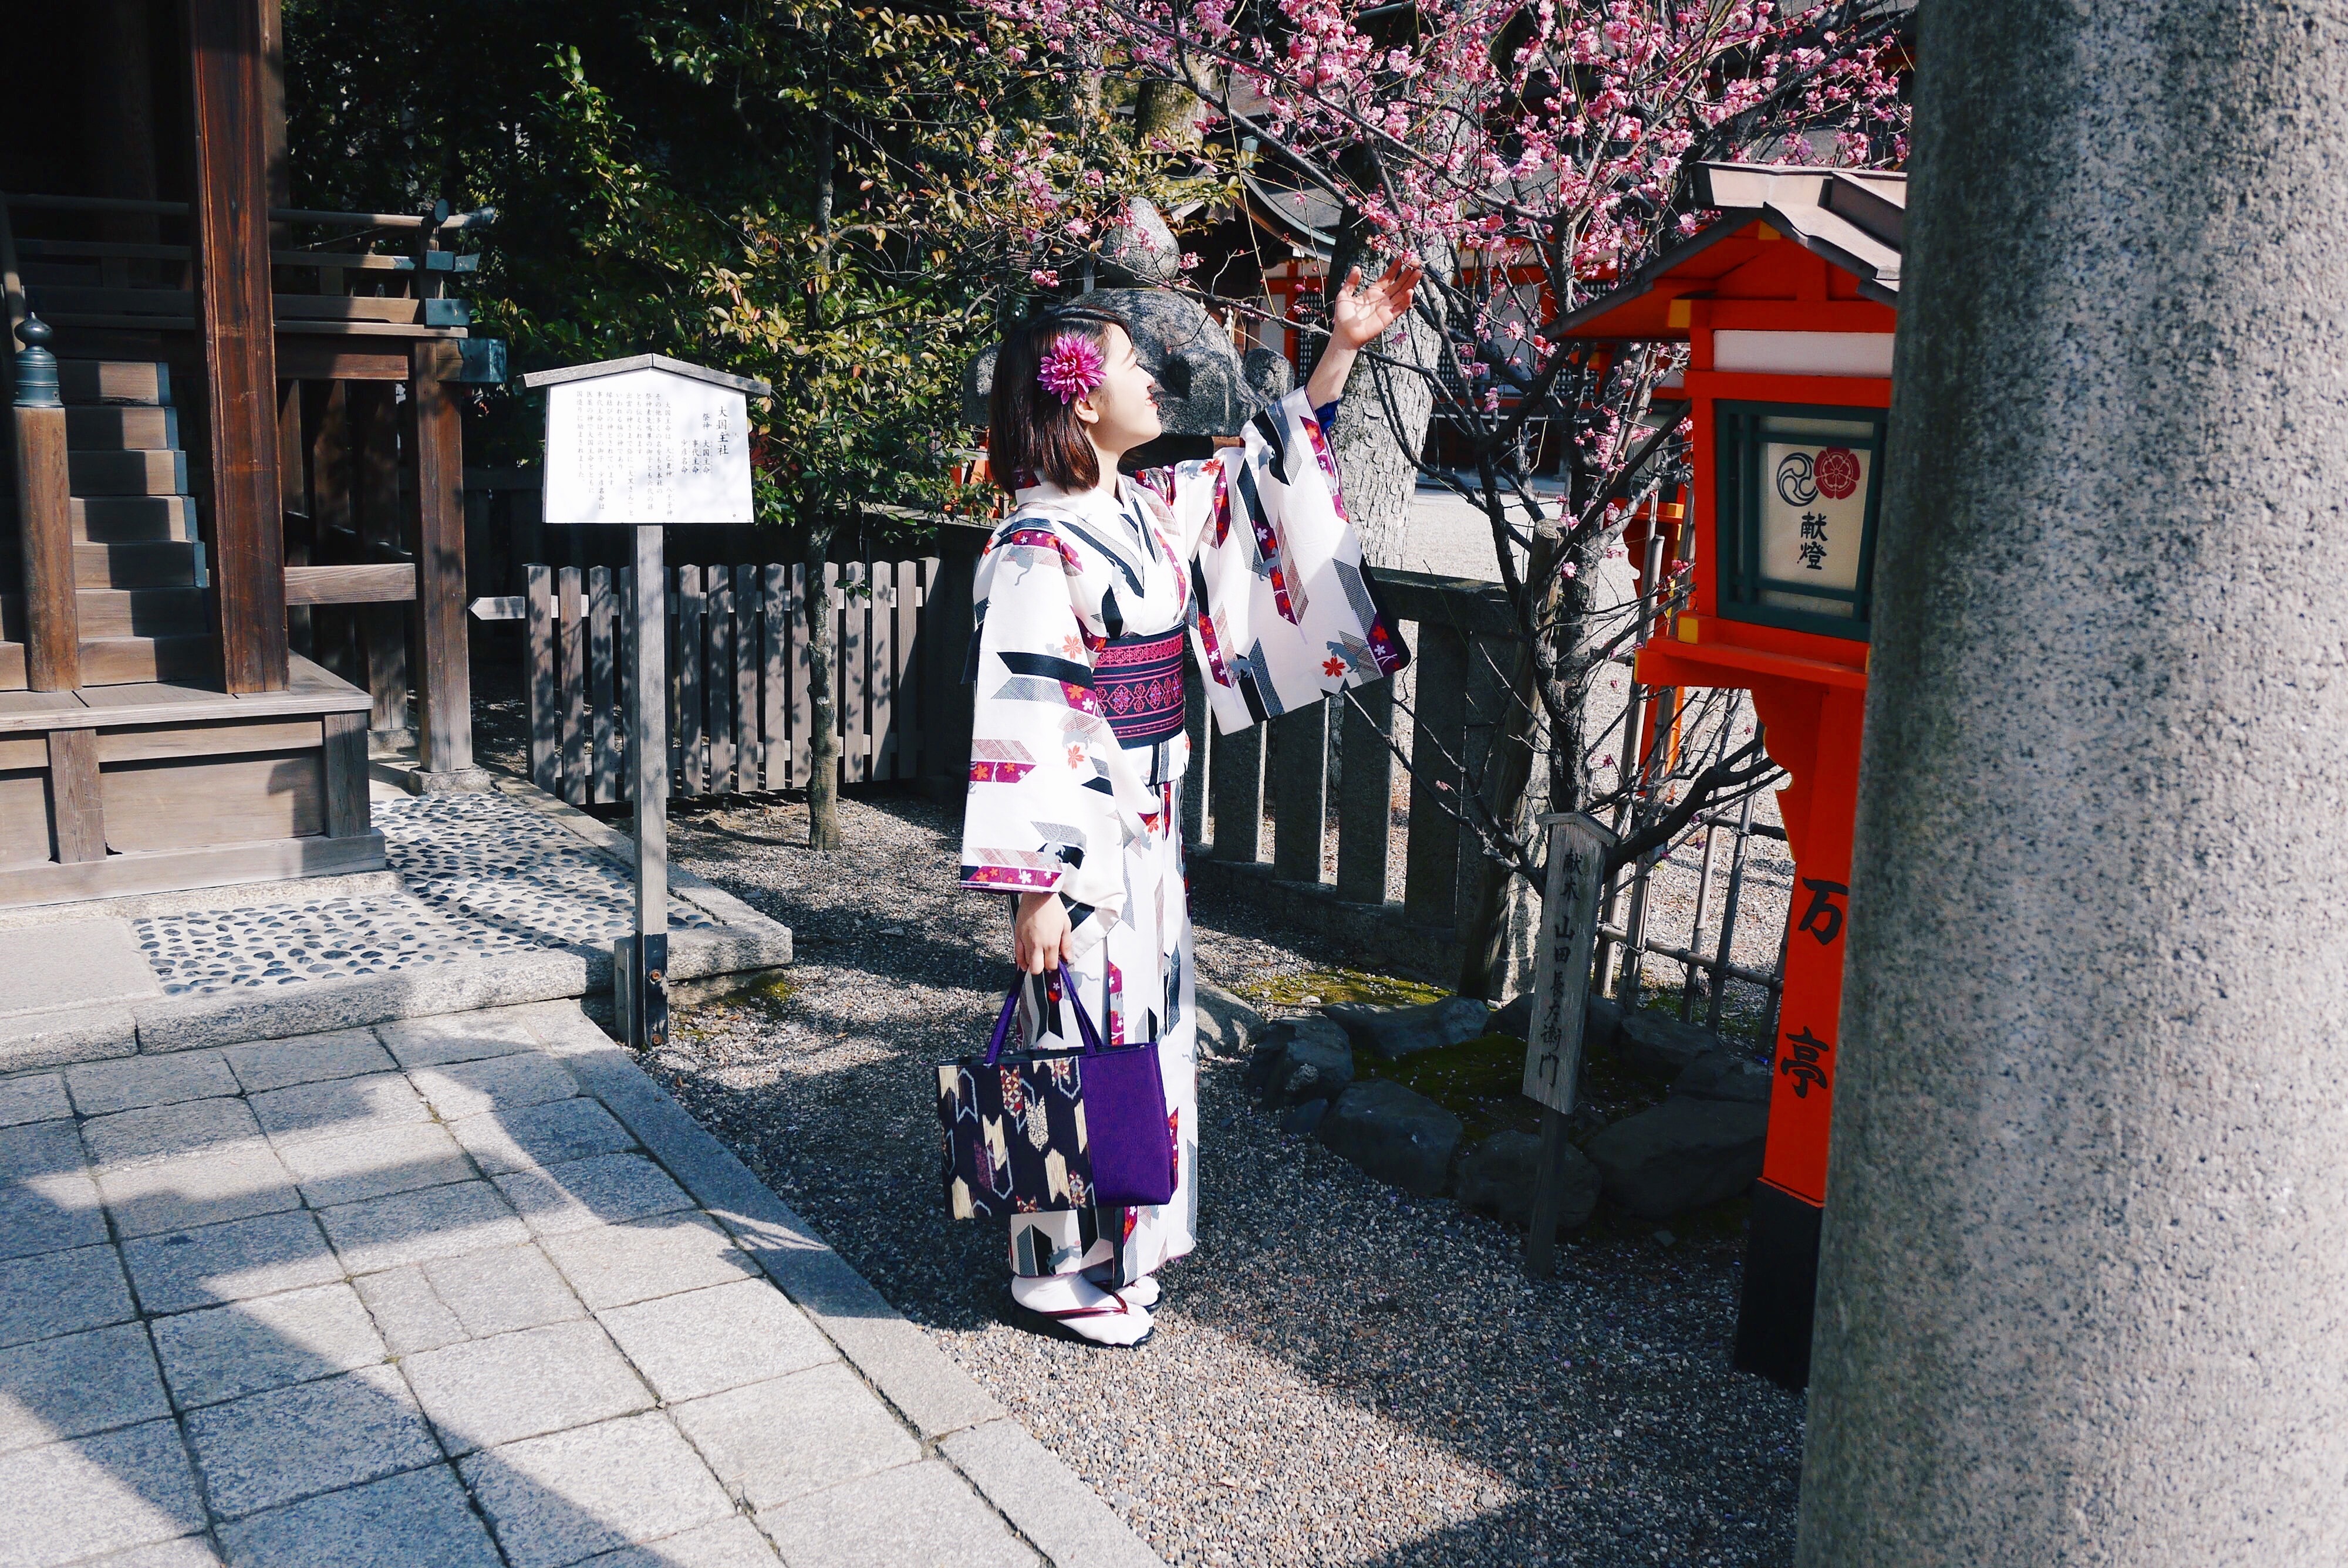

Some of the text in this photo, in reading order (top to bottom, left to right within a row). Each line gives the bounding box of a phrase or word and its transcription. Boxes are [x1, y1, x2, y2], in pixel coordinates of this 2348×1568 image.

[702, 413, 711, 474] 祭神 大国主命
[717, 405, 729, 456] 大国主社
[691, 439, 700, 474] 事代主命
